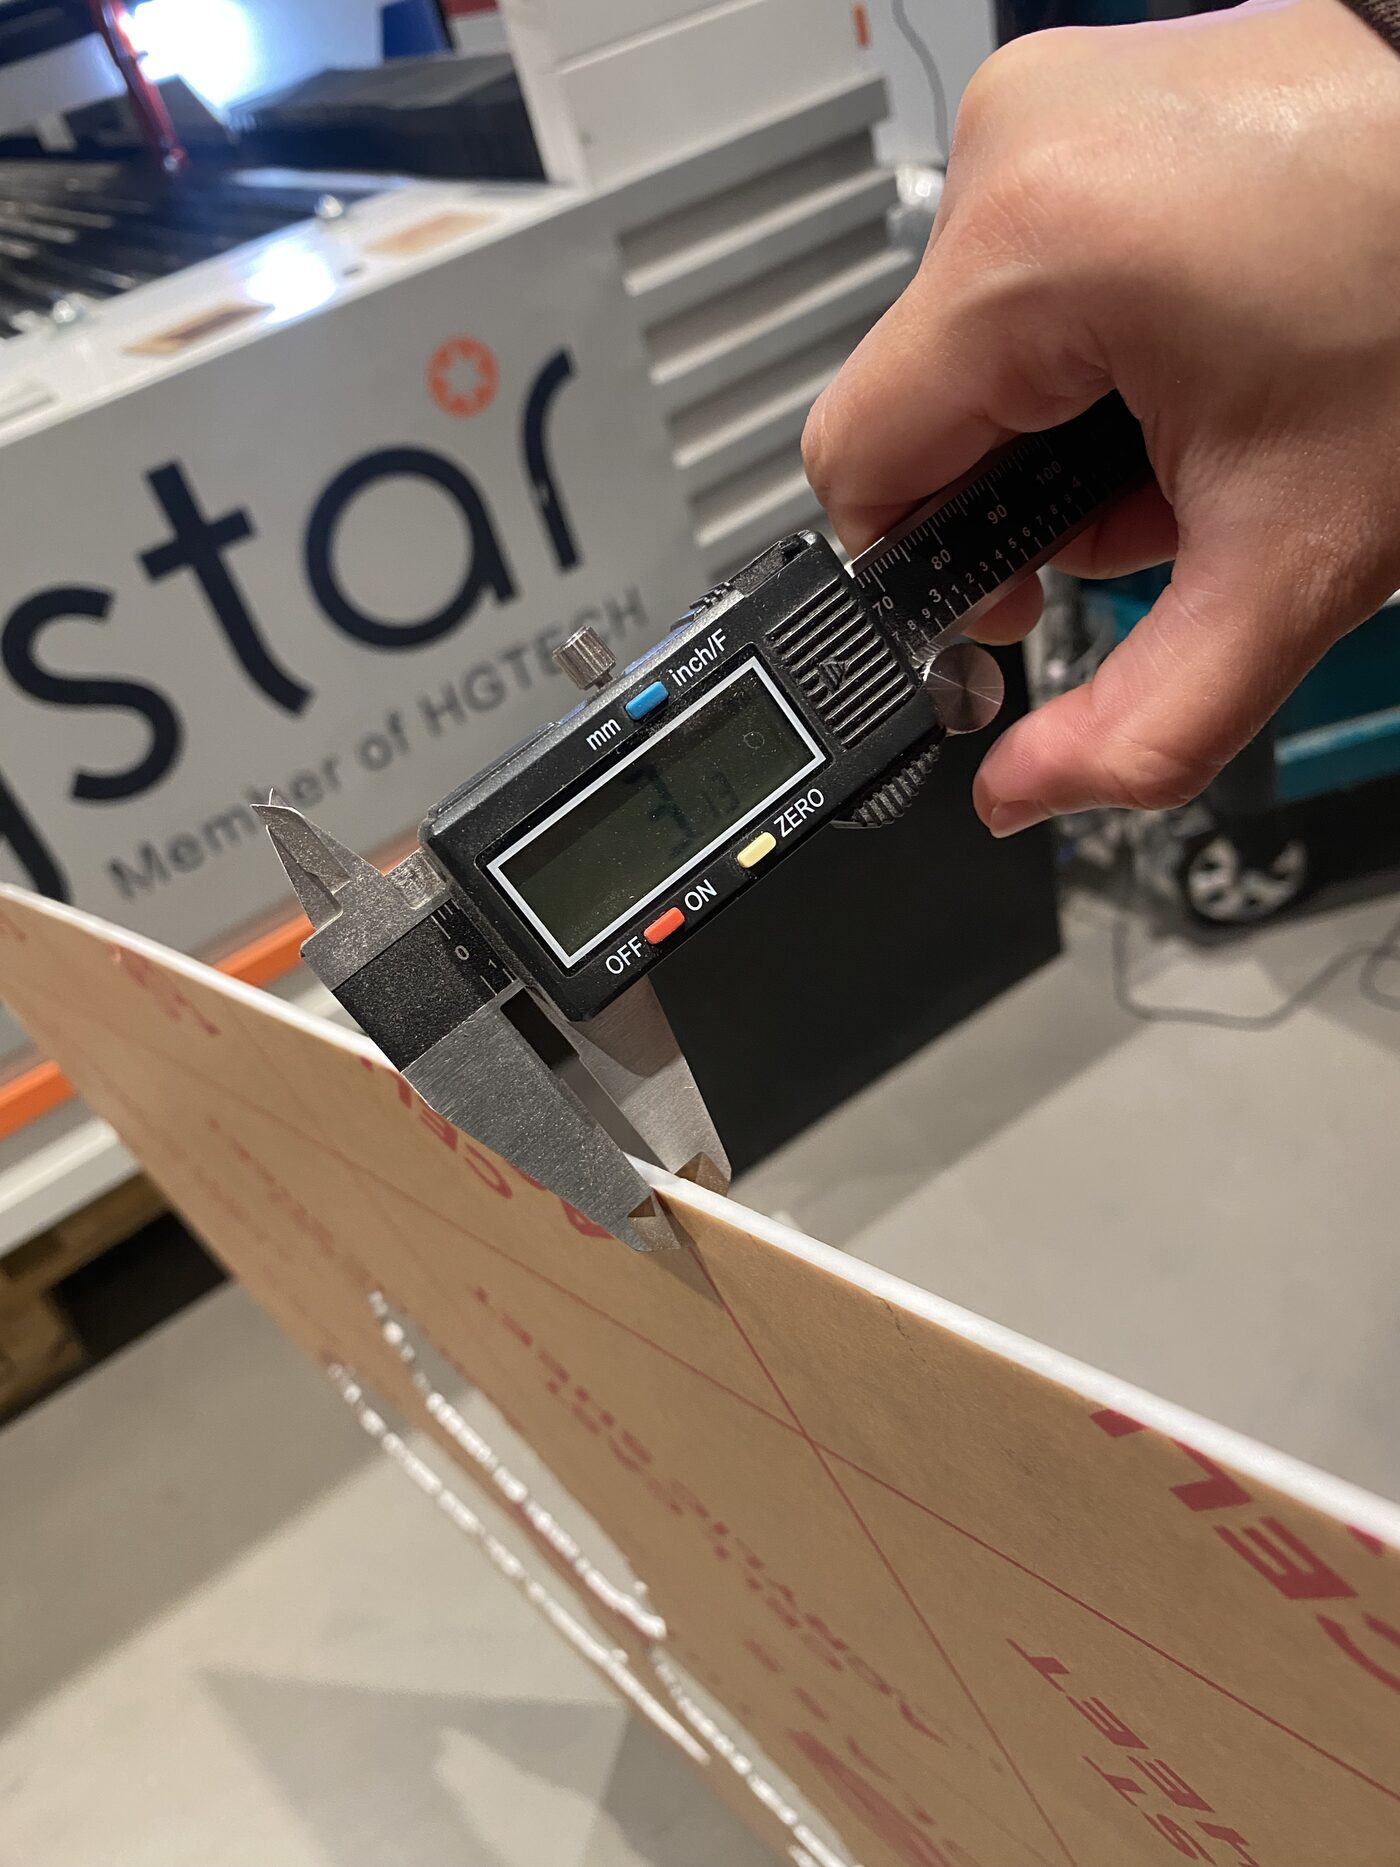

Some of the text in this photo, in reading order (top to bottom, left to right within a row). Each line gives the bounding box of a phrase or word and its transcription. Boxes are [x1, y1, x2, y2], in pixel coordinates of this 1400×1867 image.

[872, 460, 1063, 617] 70 80 90 100
[907, 619, 917, 631] 8
[921, 608, 931, 619] 9
[928, 588, 942, 603] 3
[951, 584, 960, 594] 1
[965, 572, 975, 584] 2
[979, 561, 989, 572] 3
[994, 549, 1005, 561] 4
[1007, 537, 1018, 549] 5
[1021, 526, 1032, 538] 6
[1035, 515, 1046, 527] 7
[0, 345, 578, 904] star
[585, 628, 727, 751] mm inch/F
[106, 752, 342, 902] Memer
[356, 709, 410, 772] of
[773, 788, 825, 838] ZERO
[454, 944, 470, 961] 0
[605, 878, 718, 975] OFF ON
